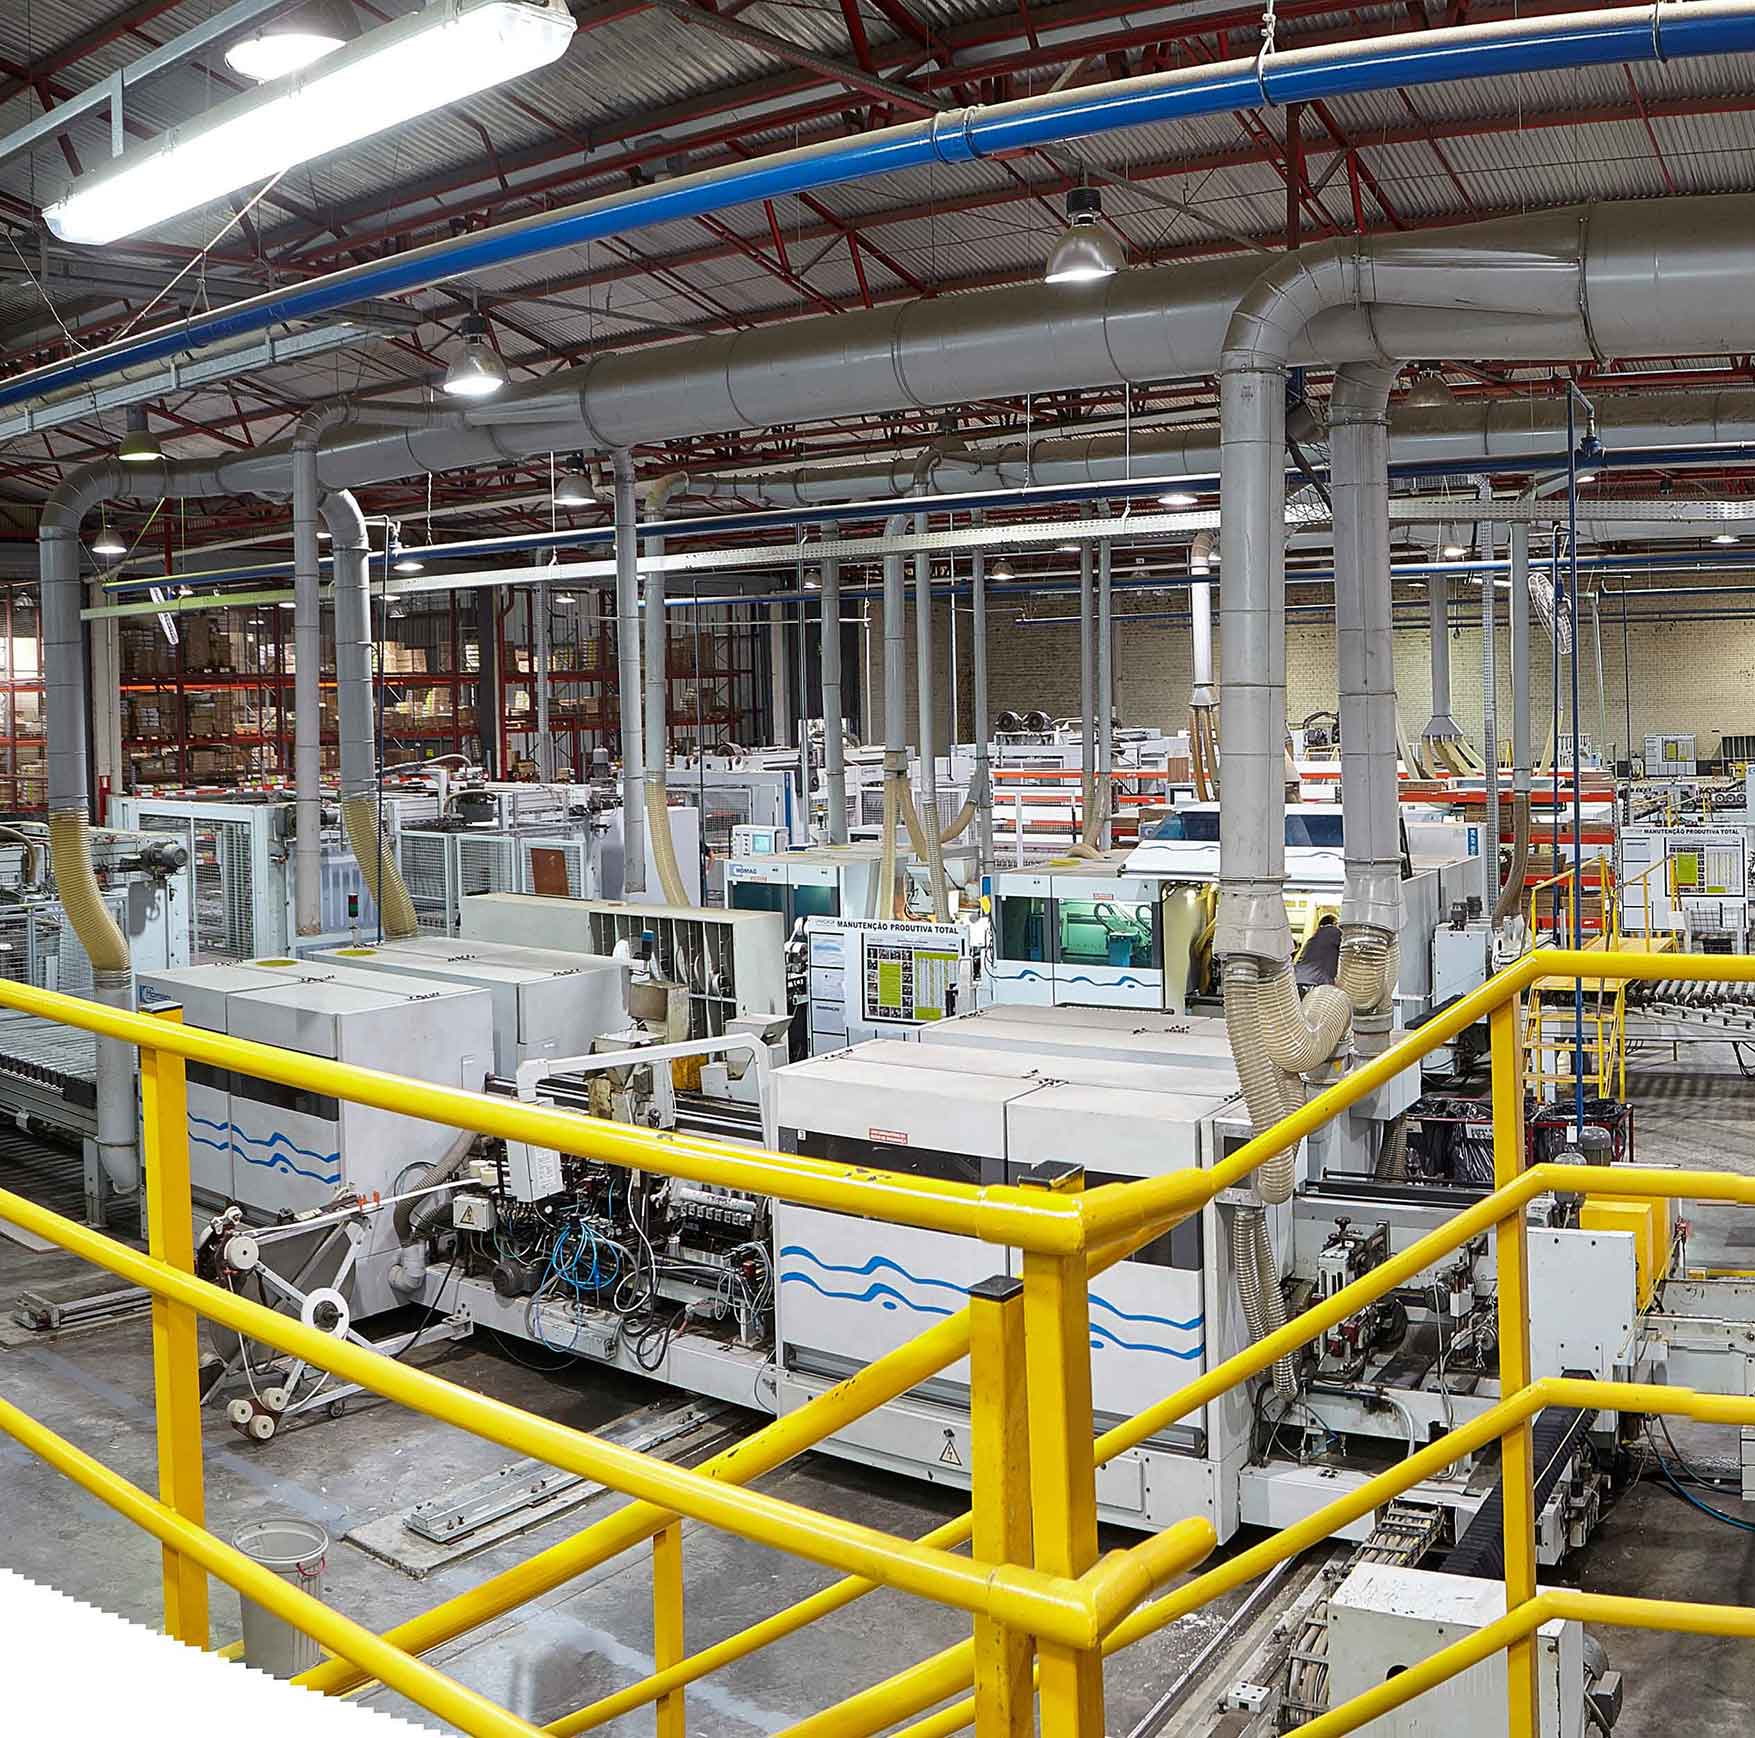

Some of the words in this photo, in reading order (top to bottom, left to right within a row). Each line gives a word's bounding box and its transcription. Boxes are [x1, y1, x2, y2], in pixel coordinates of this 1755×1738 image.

[837, 920, 888, 931] MANUTENÇÃO
[890, 923, 933, 933] PRODUTIVA
[935, 926, 959, 934] TOTAL
